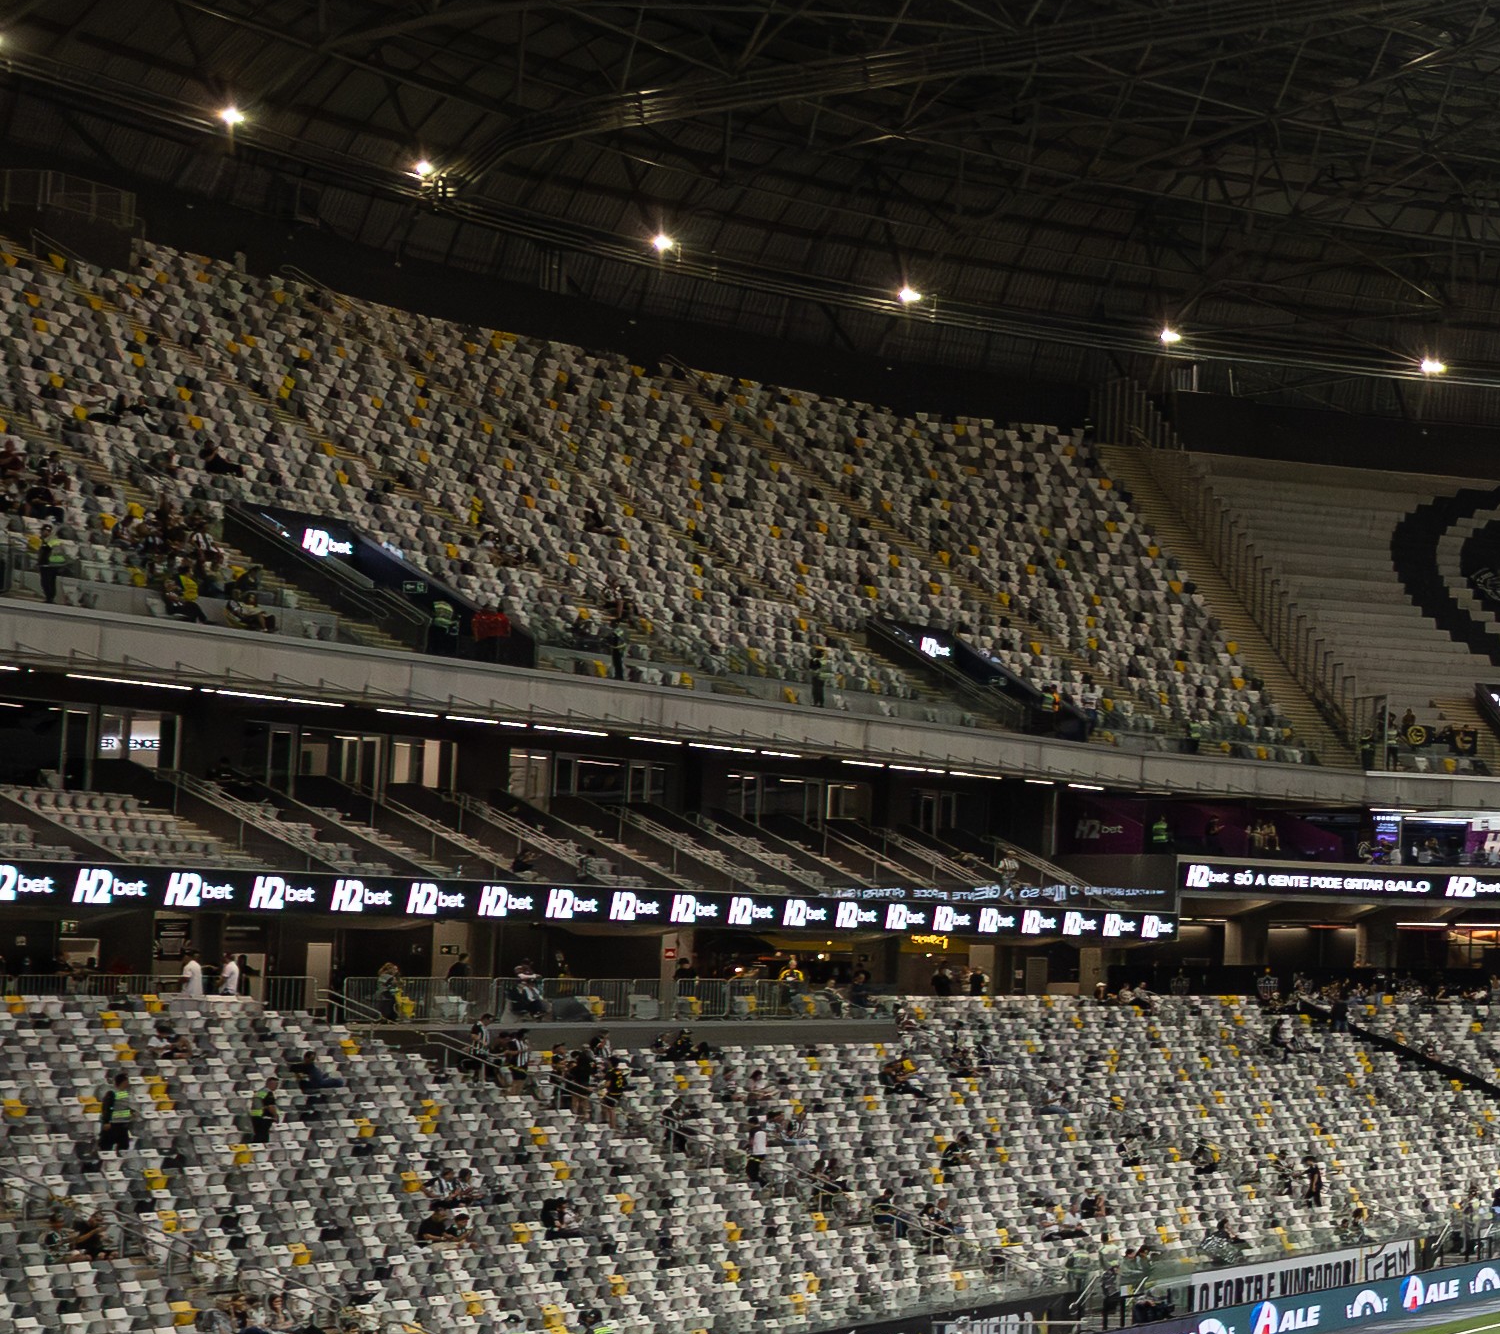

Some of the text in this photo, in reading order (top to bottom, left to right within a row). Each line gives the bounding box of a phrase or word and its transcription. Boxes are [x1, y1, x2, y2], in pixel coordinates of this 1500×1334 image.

[1233, 872, 1253, 886] SÓ
[1255, 874, 1267, 886] A
[1267, 875, 1309, 888] GENTE
[1310, 877, 1343, 890] PODE
[1343, 878, 1384, 891] GRITAR
[1385, 880, 1431, 893] GALO
[1422, 1277, 1461, 1305] ALE
[1276, 1303, 1321, 1333] ALE
